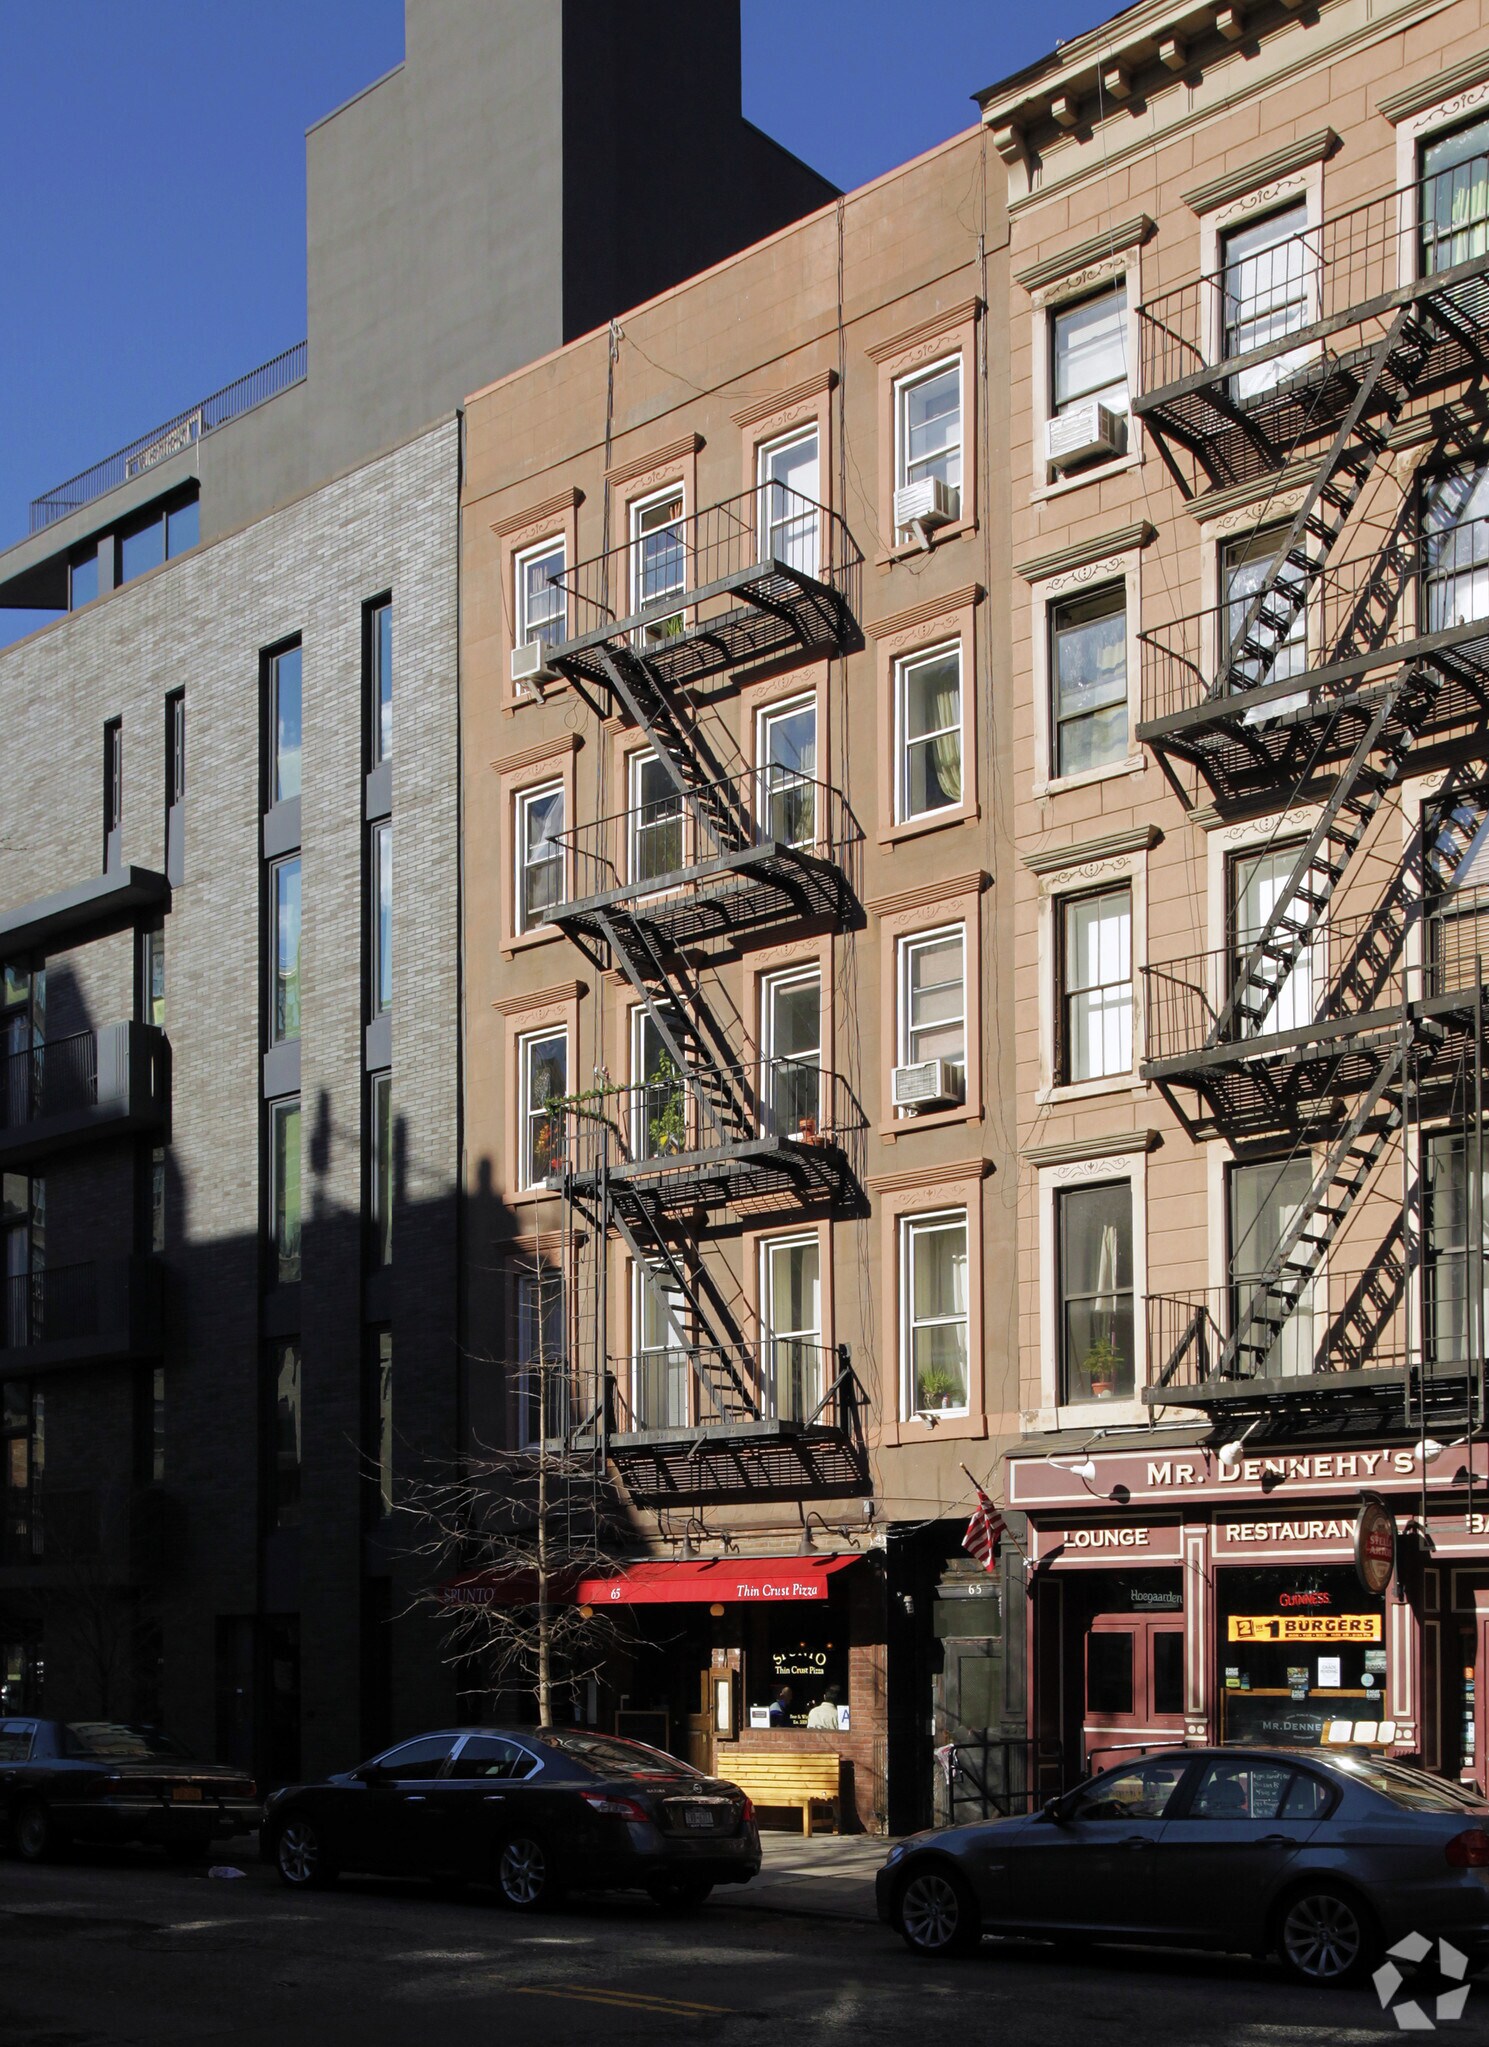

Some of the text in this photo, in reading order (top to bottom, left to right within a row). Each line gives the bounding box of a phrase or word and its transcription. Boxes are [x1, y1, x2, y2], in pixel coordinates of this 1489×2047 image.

[1147, 1449, 1415, 1486] MR. DENNEHY'S
[1063, 1528, 1149, 1548] LOUNGE
[1226, 1520, 1358, 1542] RESTAURAN
[443, 1587, 495, 1603] SPUNTO
[610, 1587, 621, 1600] 65
[736, 1583, 818, 1597] Thin Crust Pizza
[968, 1584, 982, 1595] 65
[1130, 1589, 1183, 1604] Hoegaarden
[1279, 1592, 1331, 1607] GUINNESS
[1237, 1620, 1252, 1637] 2
[1264, 1620, 1280, 1638] 1
[1285, 1619, 1374, 1631] BURGERS
[775, 1666, 825, 1675] Thin Crust Pizza
[841, 1709, 850, 1723] A
